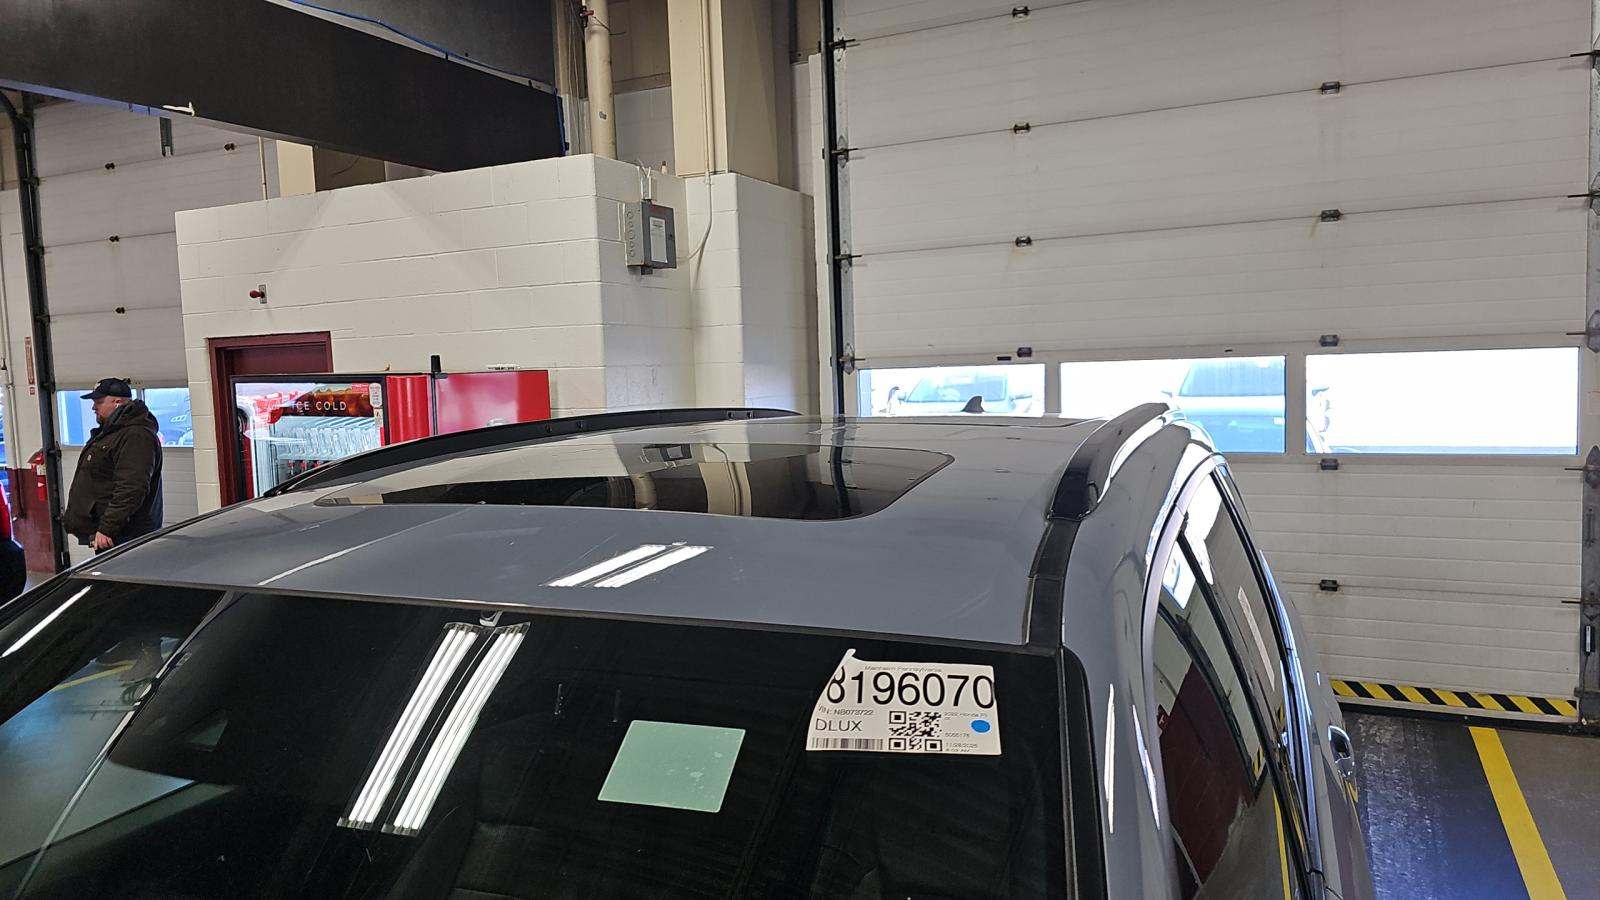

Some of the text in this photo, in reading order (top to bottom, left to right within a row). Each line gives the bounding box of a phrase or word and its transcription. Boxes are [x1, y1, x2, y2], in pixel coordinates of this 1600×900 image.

[315, 401, 347, 411] COLD
[826, 665, 995, 709] 8196070
[815, 718, 863, 732] DLUX
